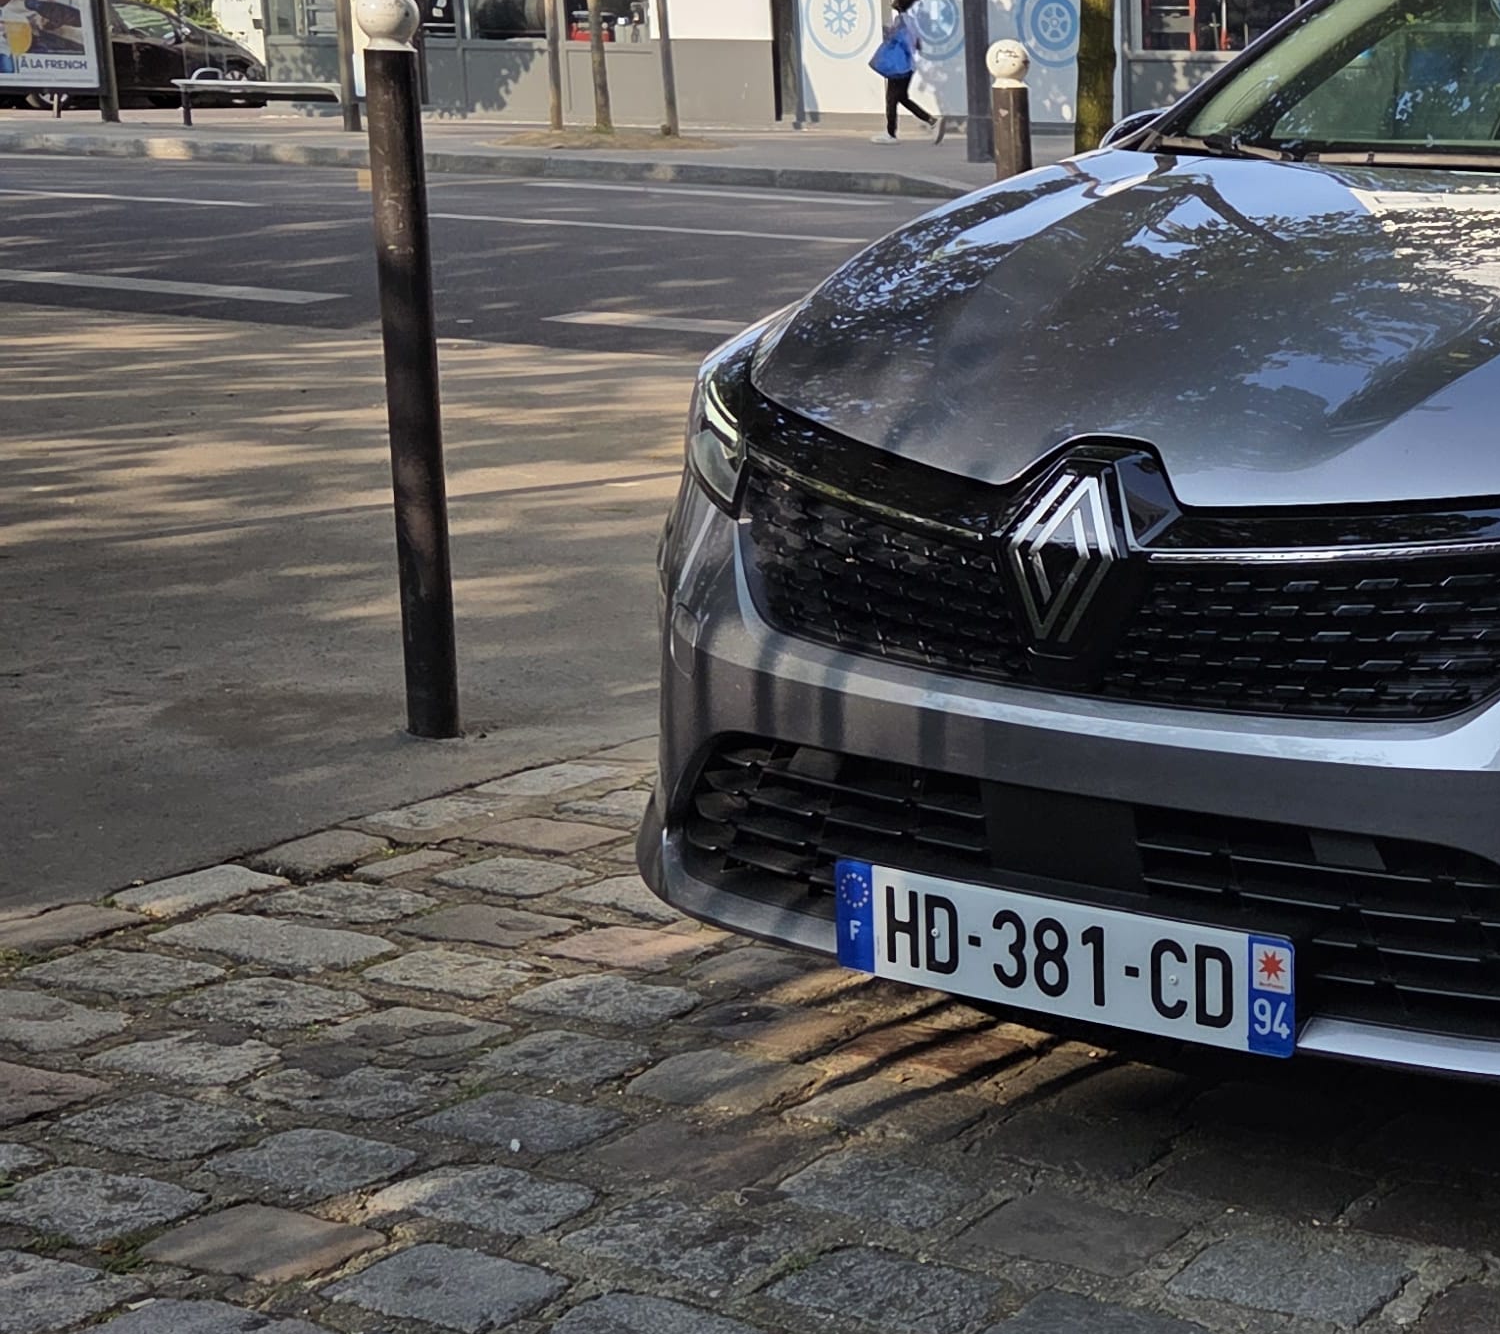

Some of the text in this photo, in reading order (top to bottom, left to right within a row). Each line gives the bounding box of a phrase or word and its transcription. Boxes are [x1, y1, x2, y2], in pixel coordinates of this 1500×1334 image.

[31, 58, 43, 68] LA
[45, 59, 88, 69] FRENCH
[850, 885, 1234, 1029] F HD-381-CD
[1253, 998, 1291, 1040] 94
